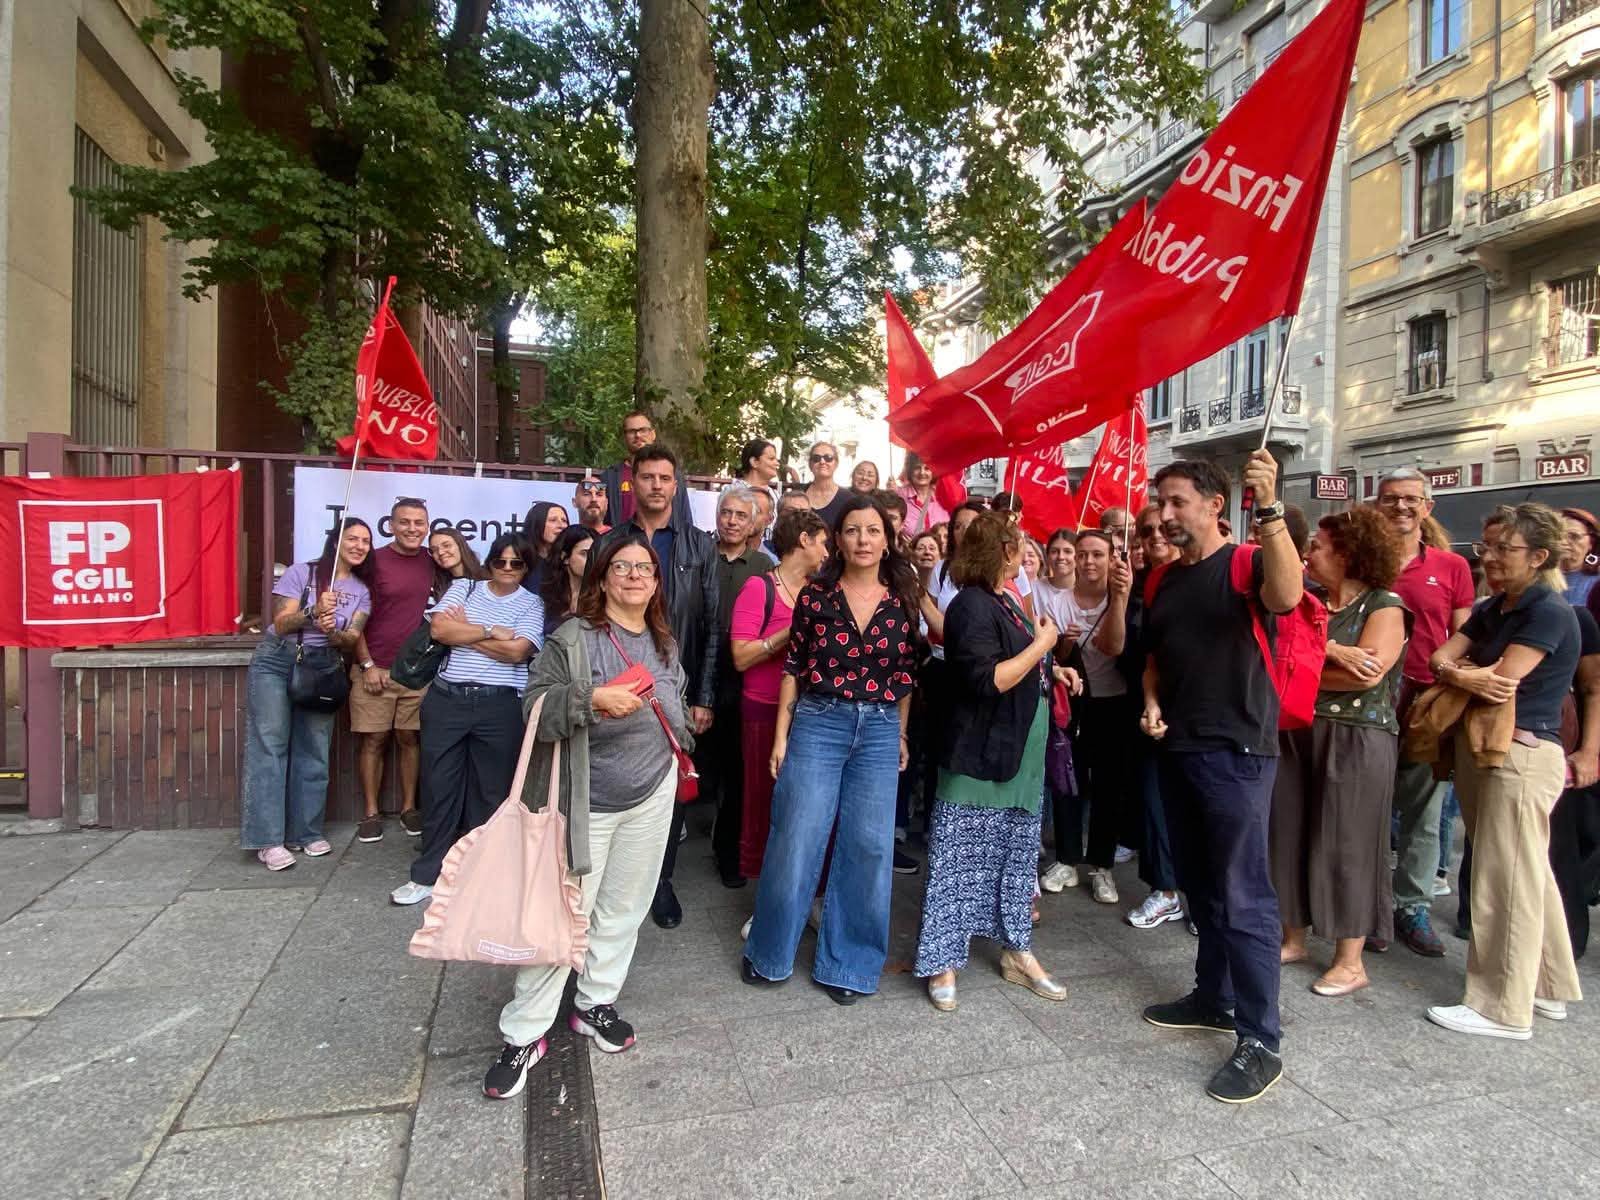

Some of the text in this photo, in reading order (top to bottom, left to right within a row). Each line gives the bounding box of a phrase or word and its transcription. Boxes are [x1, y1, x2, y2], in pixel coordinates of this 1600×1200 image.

[1540, 459, 1585, 476] BAR
[1320, 479, 1345, 491] BAR
[48, 521, 132, 566] FP
[51, 567, 134, 591] CGIL
[53, 592, 134, 605] MILANO
